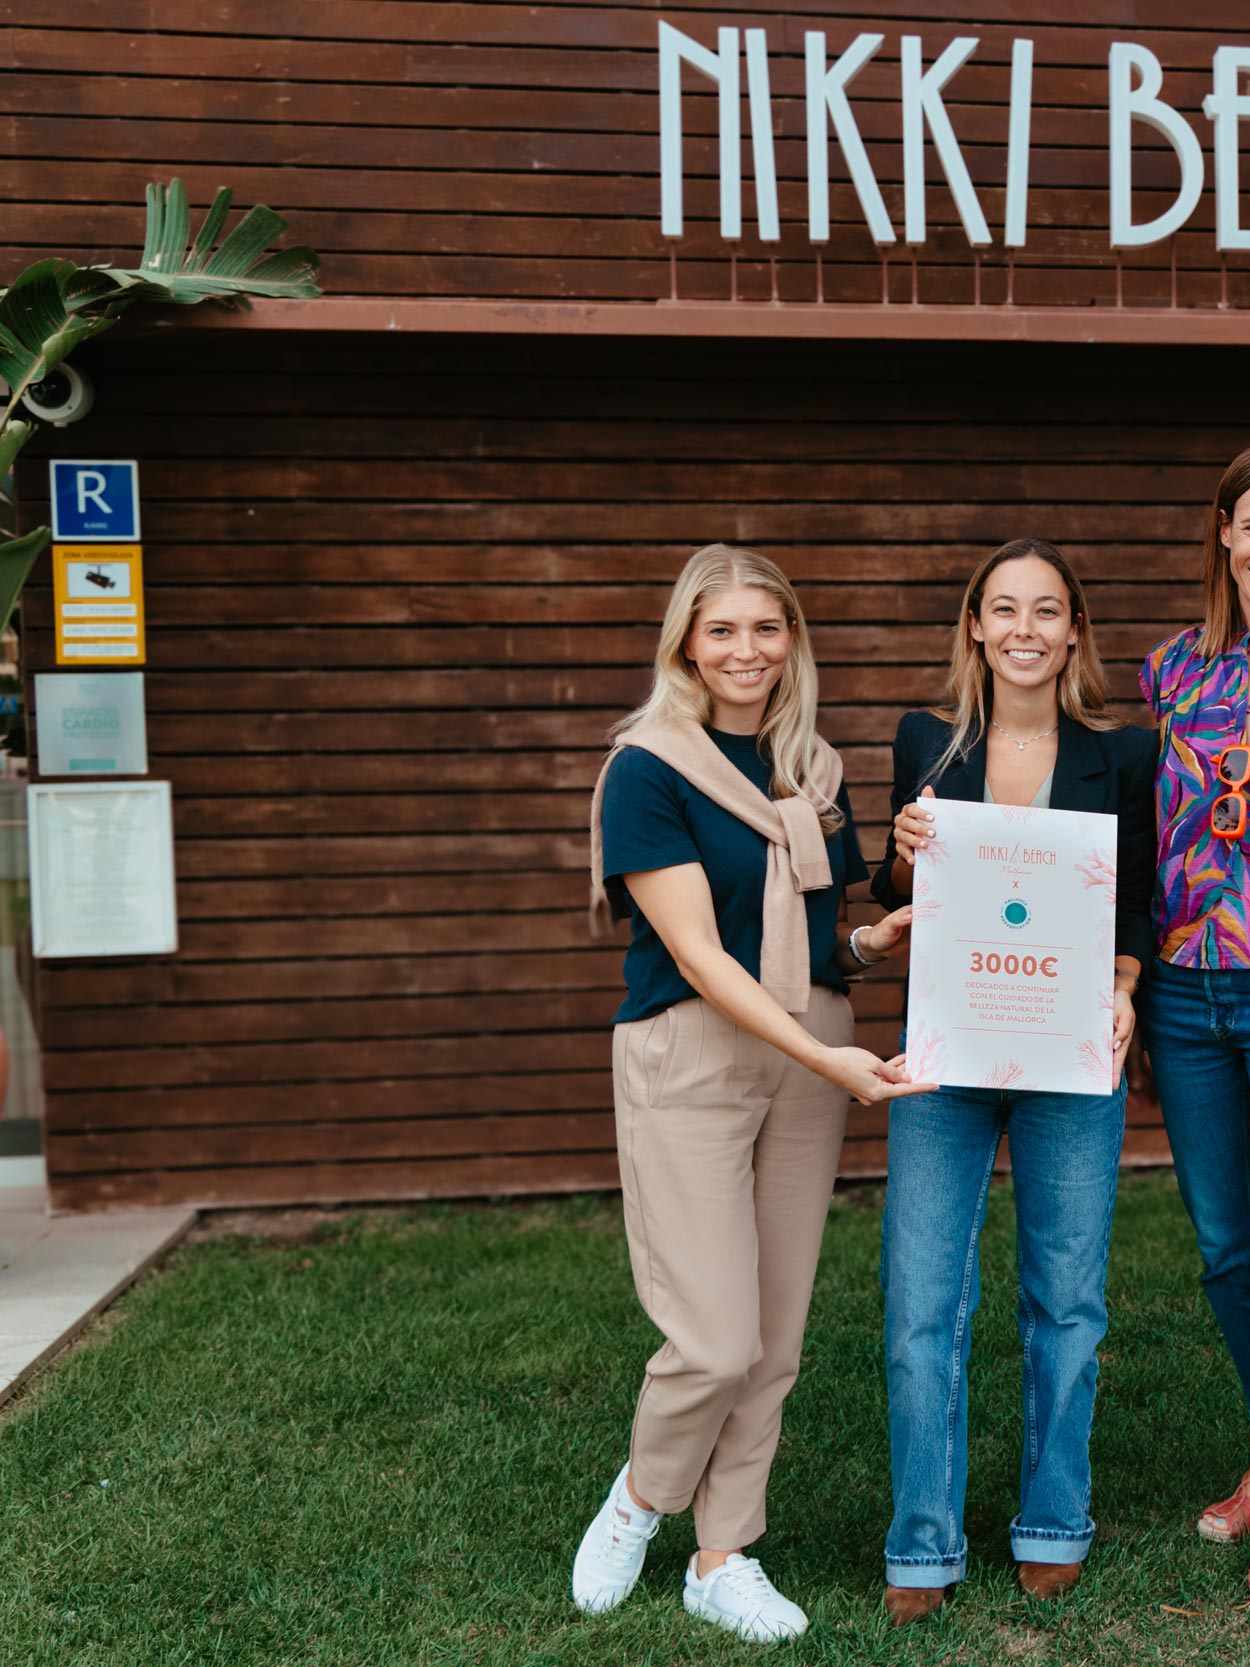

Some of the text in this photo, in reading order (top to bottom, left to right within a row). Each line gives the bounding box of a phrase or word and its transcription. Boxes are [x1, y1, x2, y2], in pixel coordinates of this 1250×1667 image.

[658, 20, 1034, 247] NIKKI
[76, 470, 113, 514] R
[62, 719, 120, 730] CARDIO
[978, 844, 1057, 866] NIKKI BEACH
[969, 951, 1059, 978] 3000€
[965, 981, 1009, 991] DEDICADOS
[1016, 985, 1060, 994] CONTINUAR
[998, 994, 1033, 1002] CUIDADO
[969, 1002, 999, 1010] BELLEZA
[1000, 1004, 1033, 1012] NATURAL
[1006, 1015, 1047, 1024] MALLORCA
